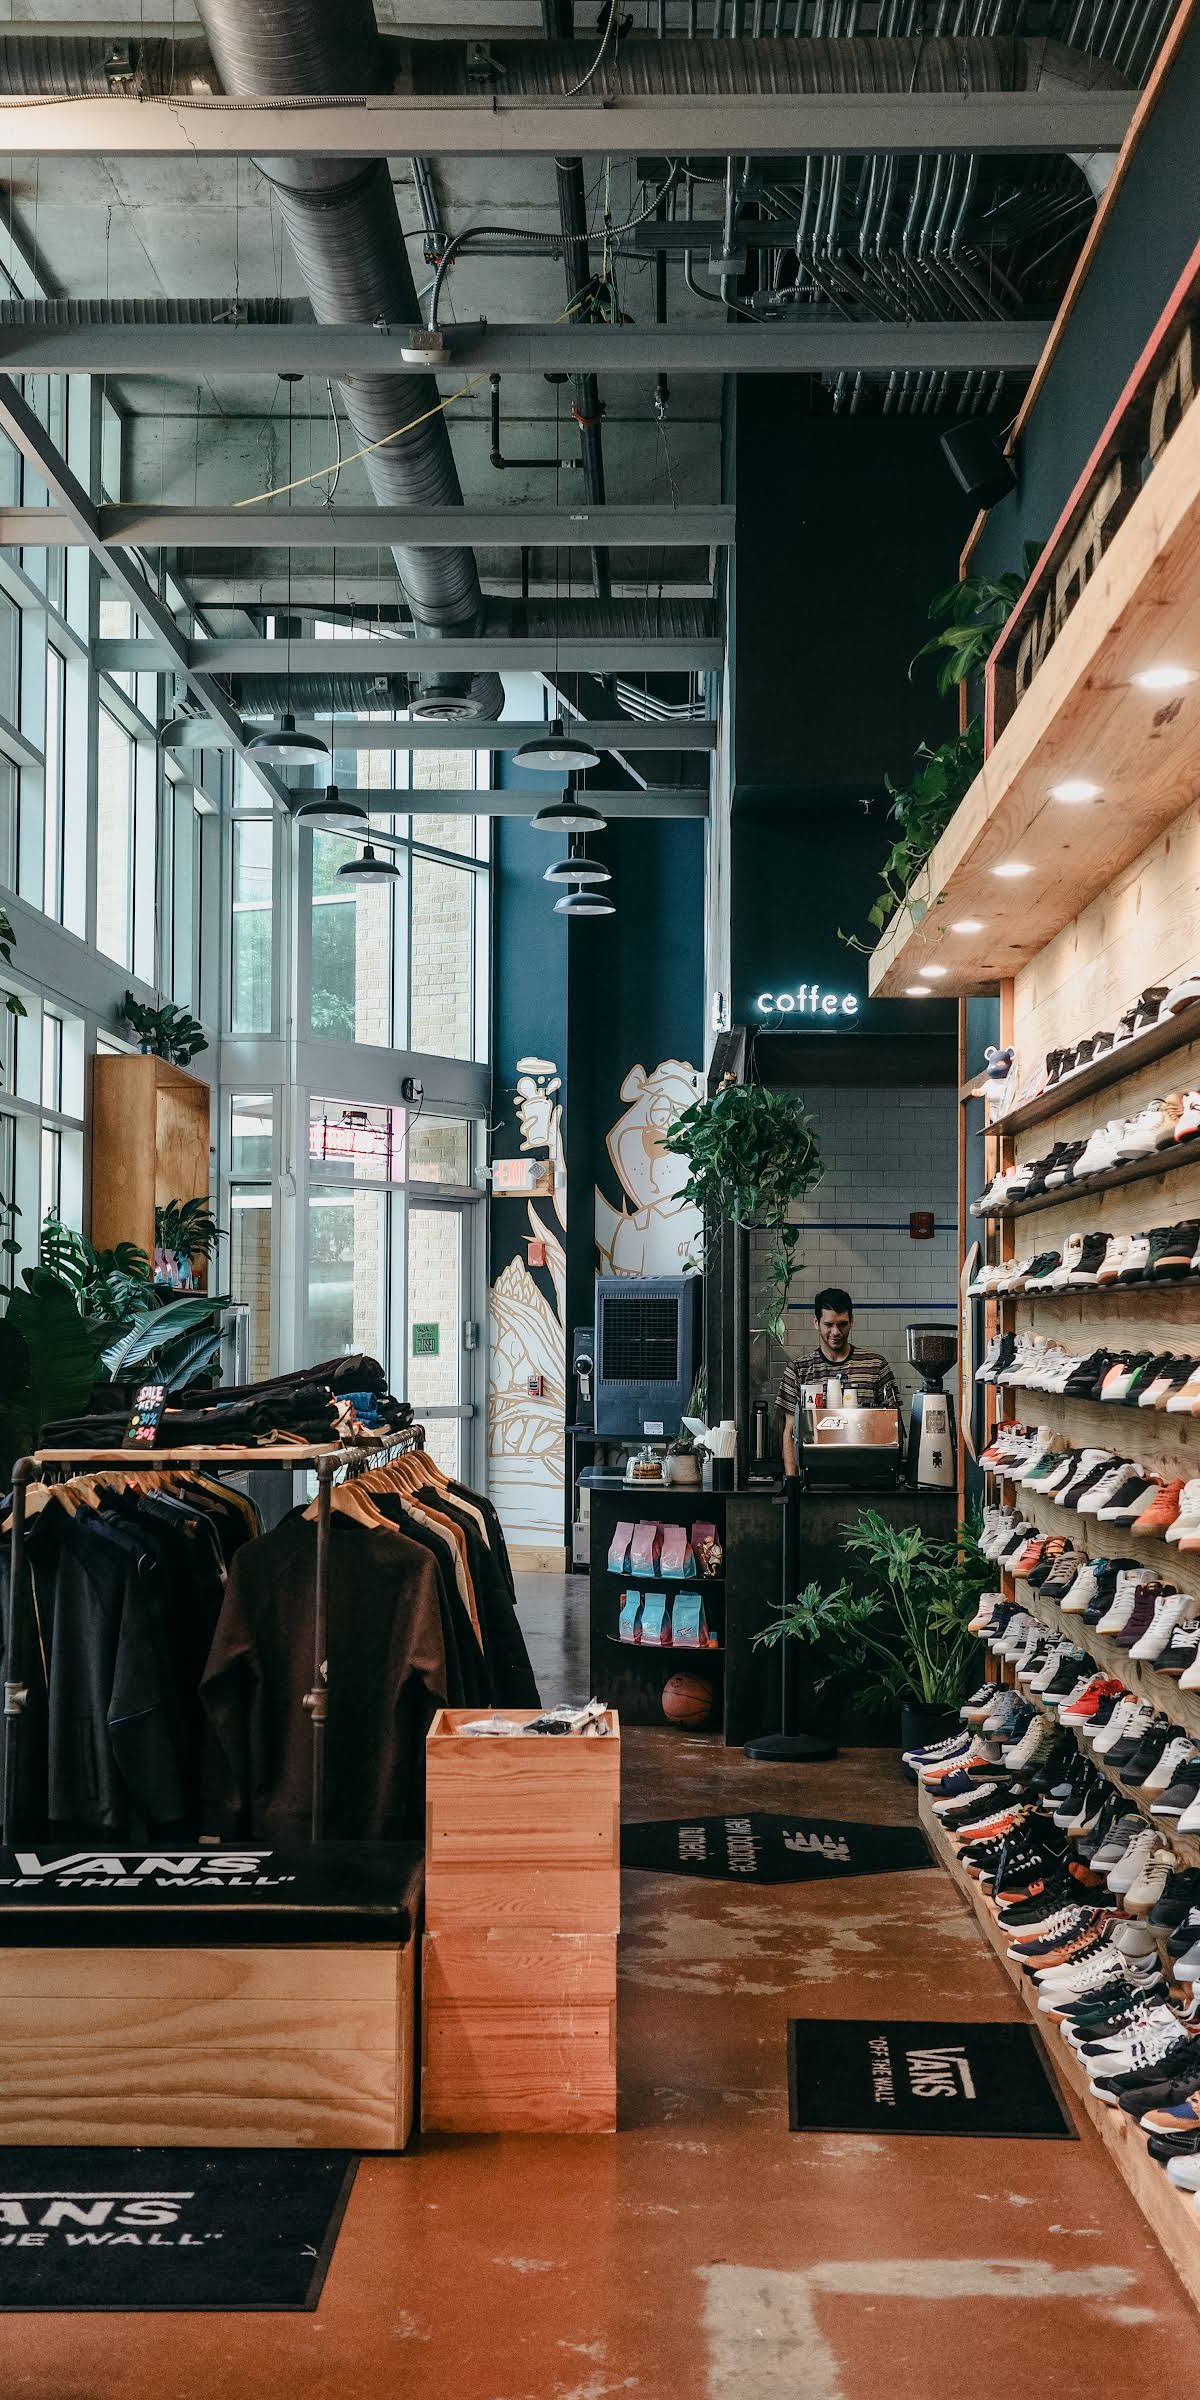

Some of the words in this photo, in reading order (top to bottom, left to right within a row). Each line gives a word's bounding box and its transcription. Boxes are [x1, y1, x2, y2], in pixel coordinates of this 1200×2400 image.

[758, 984, 858, 1015] coffee
[137, 1385, 164, 1402] SALE
[135, 1426, 156, 1441] 50%
[724, 1818, 751, 1834] new
[678, 1827, 715, 1861] numeric
[726, 1835, 763, 1873] balance
[14, 1851, 274, 1876] VANS
[55, 1878, 145, 1887] THE
[155, 1875, 296, 1887] WALL"
[868, 2036, 889, 2056] "OFF
[871, 2058, 893, 2076] THE
[905, 2046, 977, 2099] VANS
[873, 2077, 896, 2106] WALL"
[0, 2192, 195, 2226] ANS
[0, 2233, 49, 2247] HE
[65, 2230, 225, 2246] WALL"
